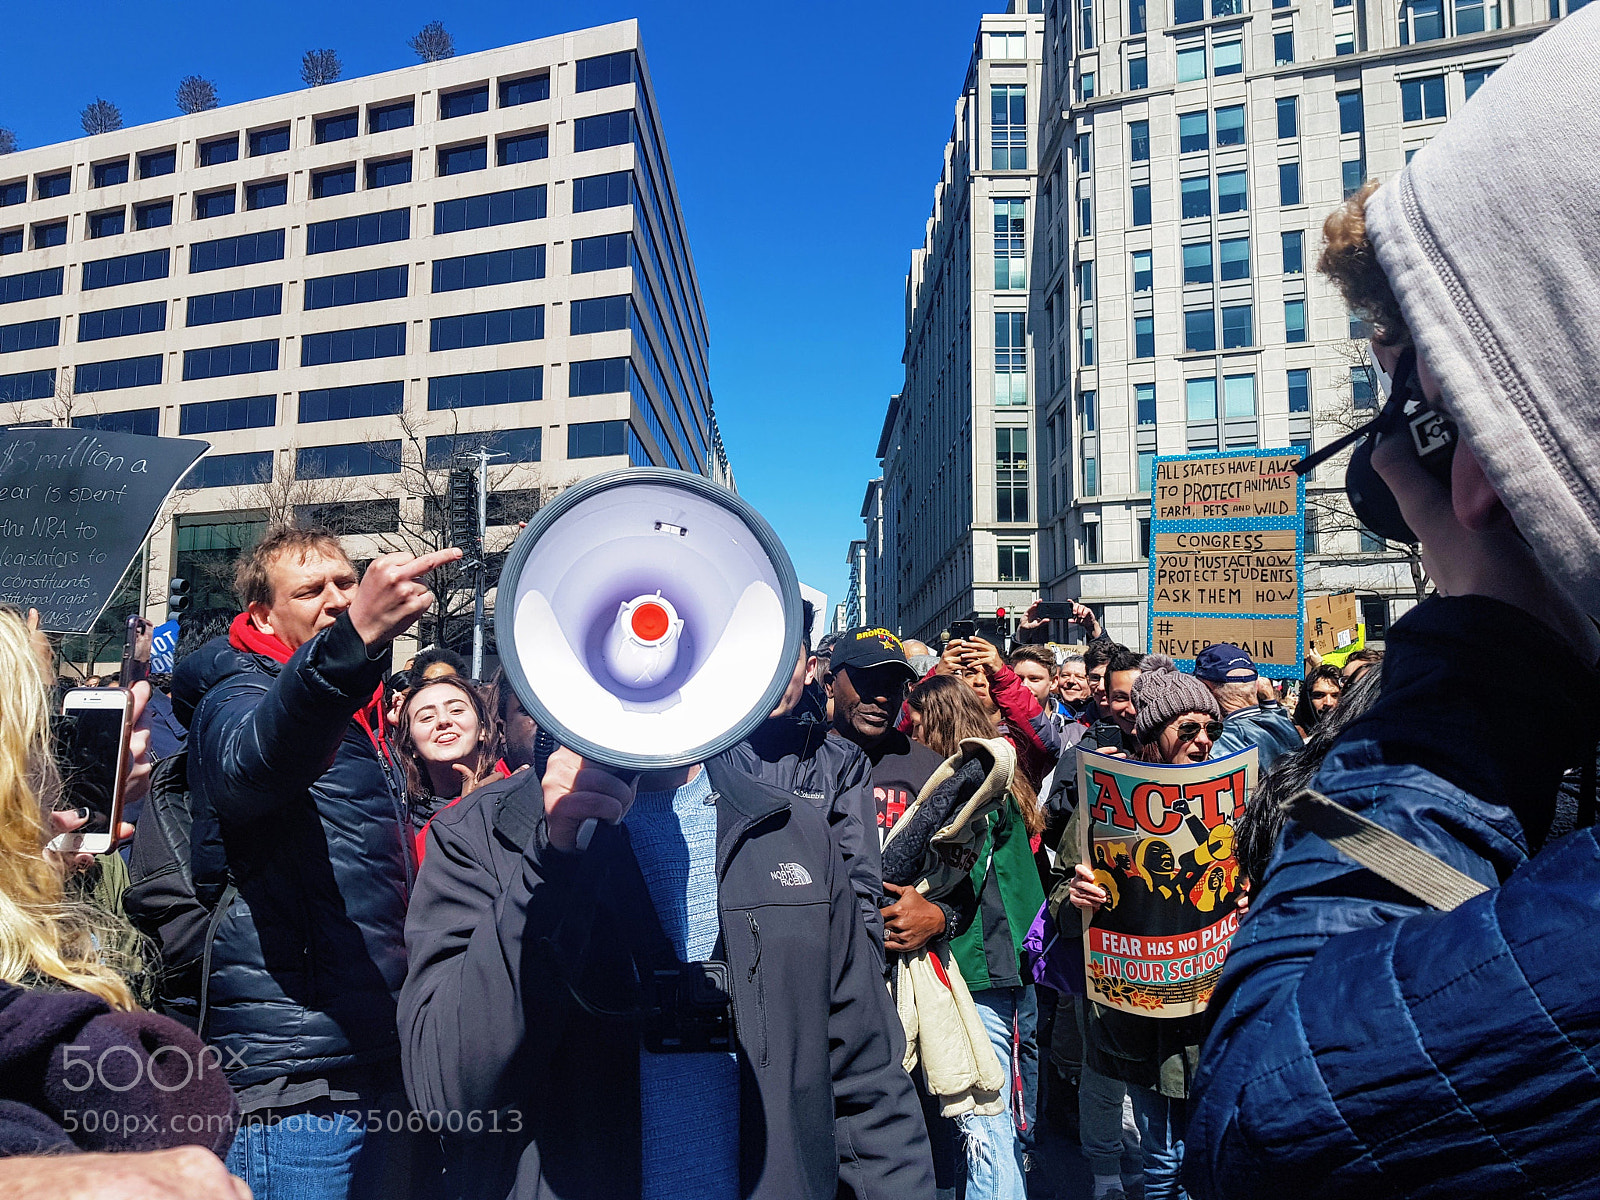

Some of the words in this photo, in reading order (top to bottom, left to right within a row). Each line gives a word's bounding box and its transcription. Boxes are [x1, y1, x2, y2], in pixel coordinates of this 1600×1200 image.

[35, 436, 124, 471] million
[131, 458, 148, 473] a
[1157, 464, 1180, 480] ALL
[1183, 462, 1226, 478] STATES
[1228, 460, 1256, 475] HAVE
[1259, 459, 1297, 476] LAWS
[45, 482, 61, 503] is
[70, 484, 127, 515] spent
[1159, 485, 1178, 499] TO
[1183, 481, 1242, 504] PROTECT
[1244, 476, 1290, 493] ANIMALS
[1161, 505, 1195, 517] FARM,
[1203, 503, 1229, 516] PETS
[1233, 504, 1251, 512] AND
[1254, 500, 1289, 515] WILD
[0, 517, 24, 538] the
[31, 516, 68, 540] NRA
[75, 521, 98, 540] to
[1177, 534, 1263, 549] CONGRESS
[0, 546, 79, 568] legislators
[88, 547, 107, 566] to
[1160, 555, 1188, 568] YOU
[1256, 555, 1293, 567] NOW
[1, 572, 91, 589] constituents
[1158, 569, 1218, 585] PROTECT
[1223, 568, 1293, 583] STUDENTS
[1157, 588, 1191, 602] ASK
[1198, 588, 1241, 604] THEM
[1256, 588, 1295, 602] HOW
[1157, 620, 1174, 636] #
[1222, 640, 1274, 658] AIN
[1090, 767, 1248, 836] ACT!
[778, 862, 795, 871] THE
[770, 870, 796, 881] NORTH
[780, 878, 802, 887] FACE
[1101, 931, 1143, 957] FEAR
[1147, 940, 1174, 956] HAS
[1178, 938, 1198, 953] NO
[1201, 912, 1240, 949] PLAC
[1102, 955, 1121, 979] IN
[1125, 960, 1165, 983] OUR
